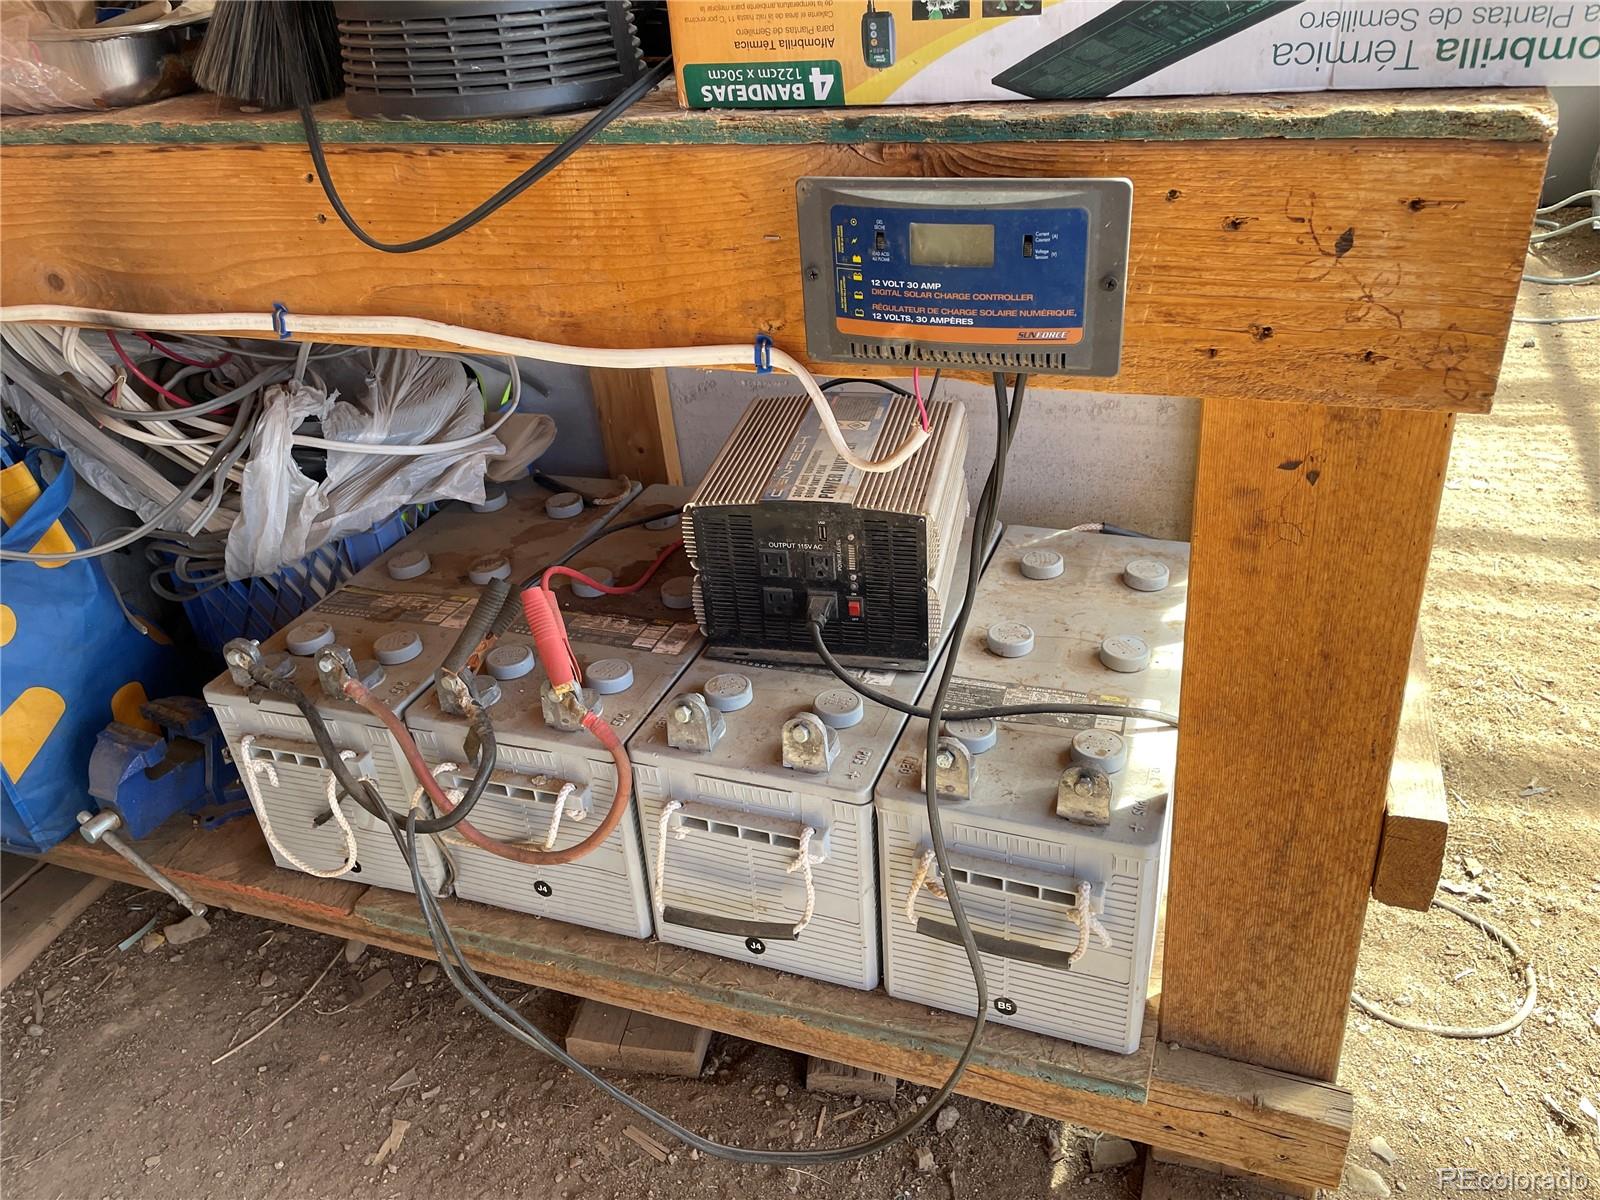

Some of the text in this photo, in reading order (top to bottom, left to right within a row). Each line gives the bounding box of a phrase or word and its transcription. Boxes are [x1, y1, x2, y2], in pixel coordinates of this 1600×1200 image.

[1299, 7, 1420, 33] Semillero
[1428, 7, 1463, 30] de
[1472, 6, 1572, 30] Plantas
[735, 24, 835, 37] para Plantas de Semillero
[733, 37, 836, 51] Alfombrilla Térmica
[1272, 38, 1420, 72] Térmica
[707, 67, 802, 82] 122cm x 50cm
[700, 66, 836, 103] 4 BANDEJAS
[870, 279, 942, 290] 12 VOLT 30 AMP
[871, 288, 1034, 302] DIGITAL SOLAR CHARGE CONTROLLER
[872, 302, 929, 314] RÉGULATEUR
[930, 306, 939, 315] DE
[941, 306, 977, 316] CHARGE
[979, 307, 1018, 317] SOLAIRE
[872, 313, 974, 326] 12 VOLTS, 30 AMPÈRES
[1017, 330, 1069, 341] SUNFORCE
[818, 473, 843, 500] POWER
[768, 541, 796, 549] OUTPUT
[537, 884, 549, 894] J4
[749, 941, 762, 951] J4
[997, 1001, 1012, 1011] B5
